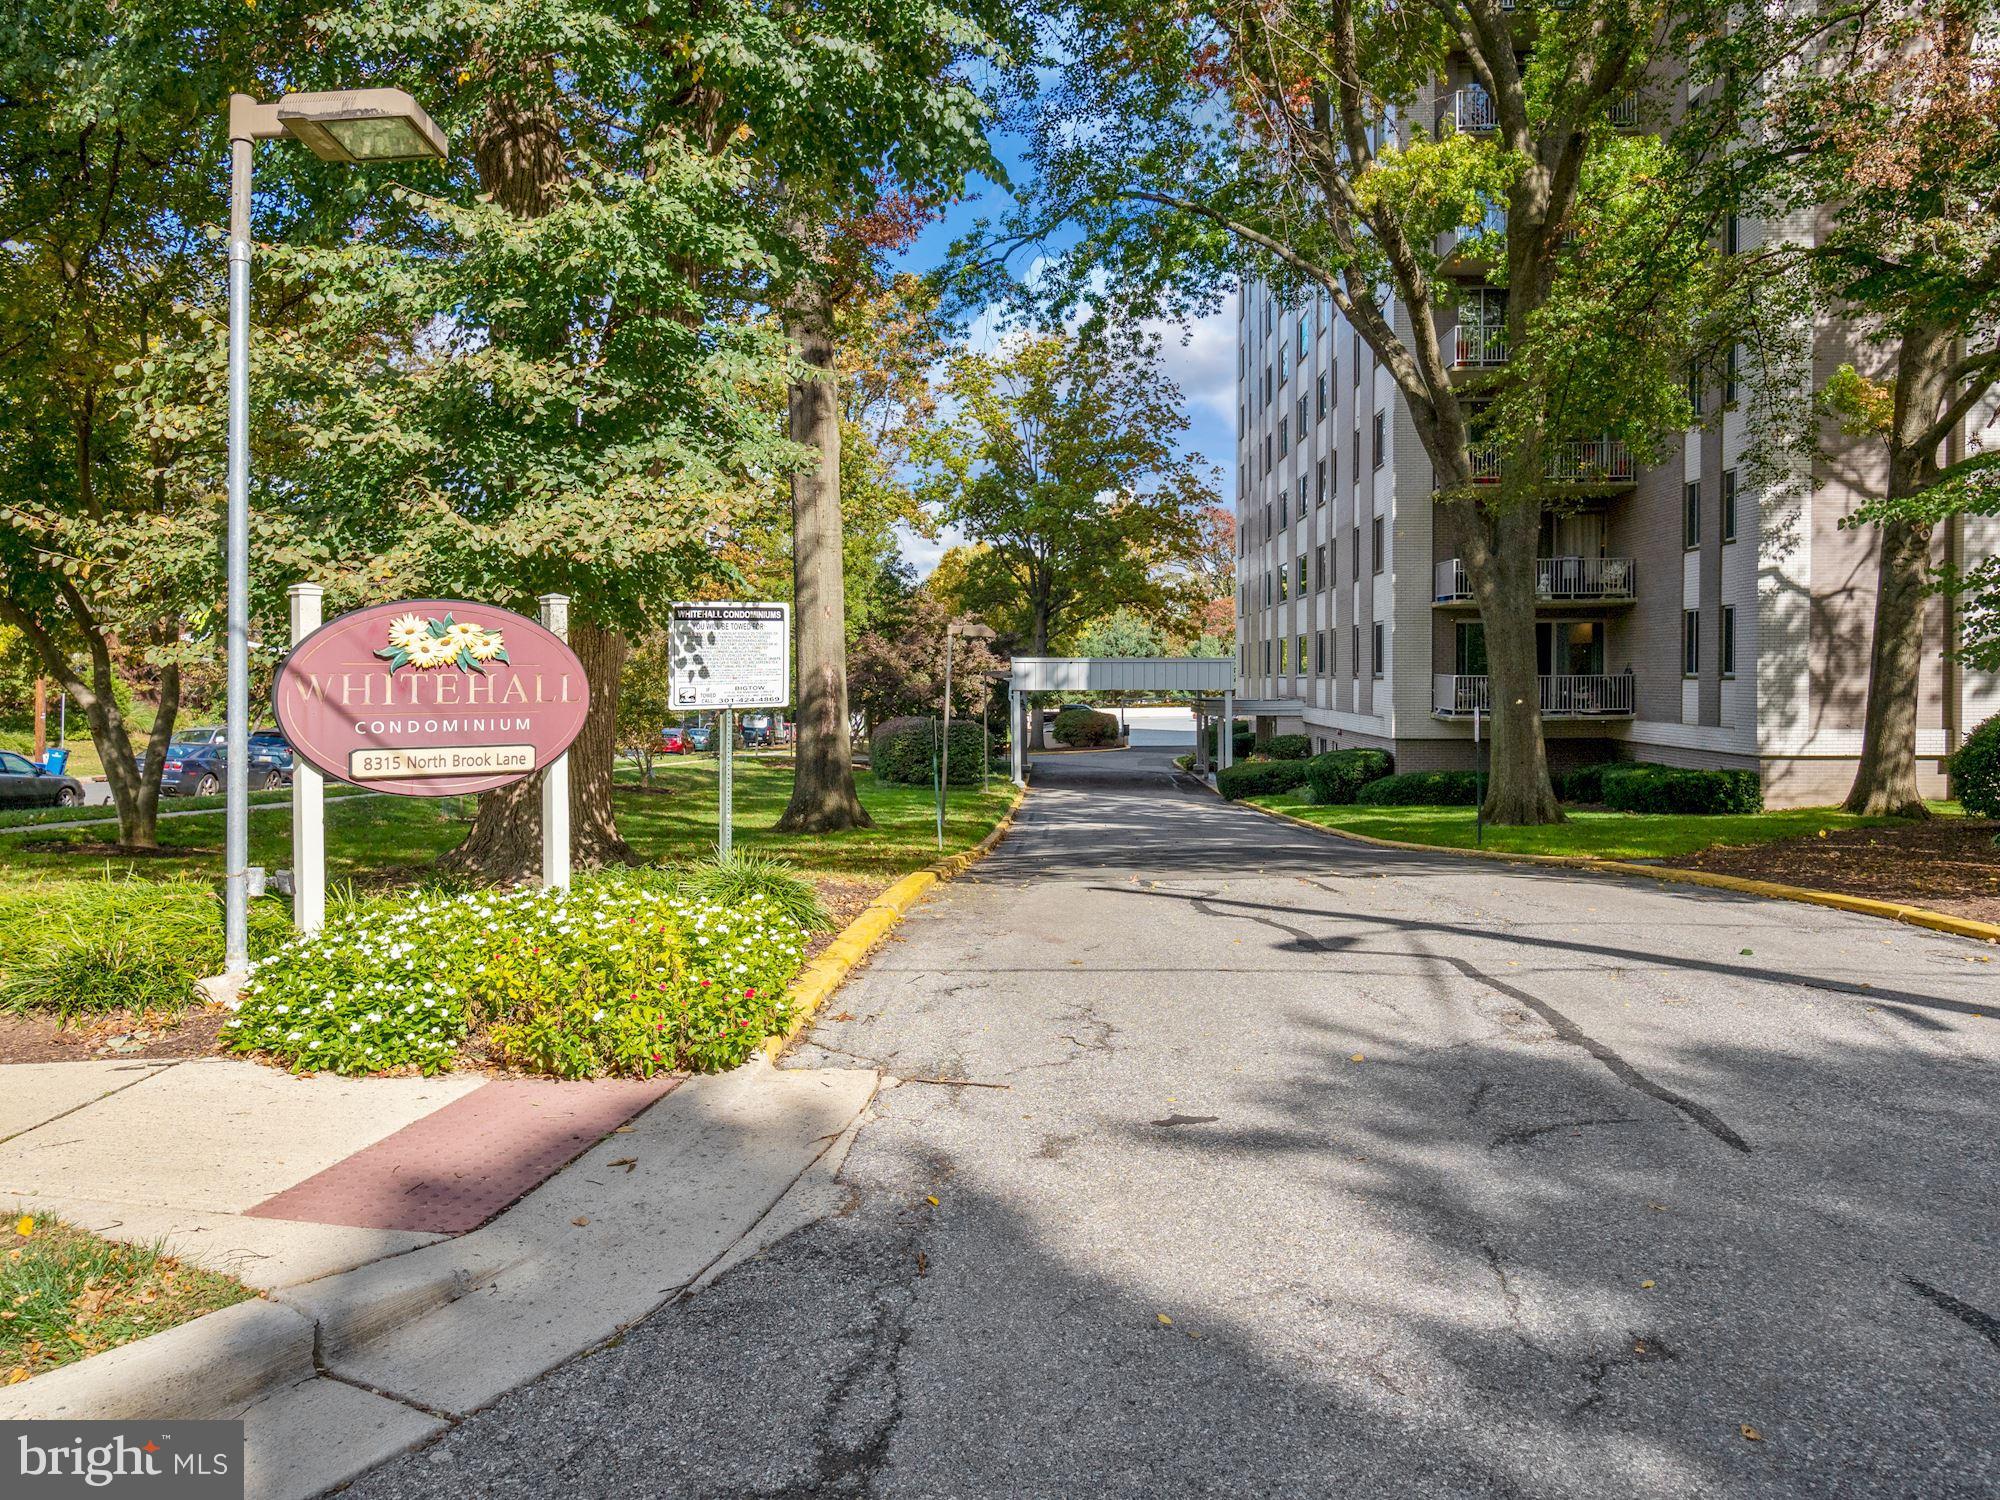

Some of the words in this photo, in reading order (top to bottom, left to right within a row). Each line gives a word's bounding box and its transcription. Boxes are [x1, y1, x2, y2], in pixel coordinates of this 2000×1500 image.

[677, 610, 722, 618] WHITEHALL
[723, 610, 781, 618] CONDOMINIUMS
[692, 622, 705, 630] YOU
[706, 622, 721, 630] WILL
[722, 622, 730, 630] BE
[730, 622, 751, 630] TOWED
[295, 672, 582, 705] WHITEHALL
[354, 717, 531, 735] CONDOMINIUM
[363, 756, 401, 771] 8315
[407, 752, 447, 769] North
[452, 751, 492, 767] Brook
[496, 752, 527, 766] Lane
